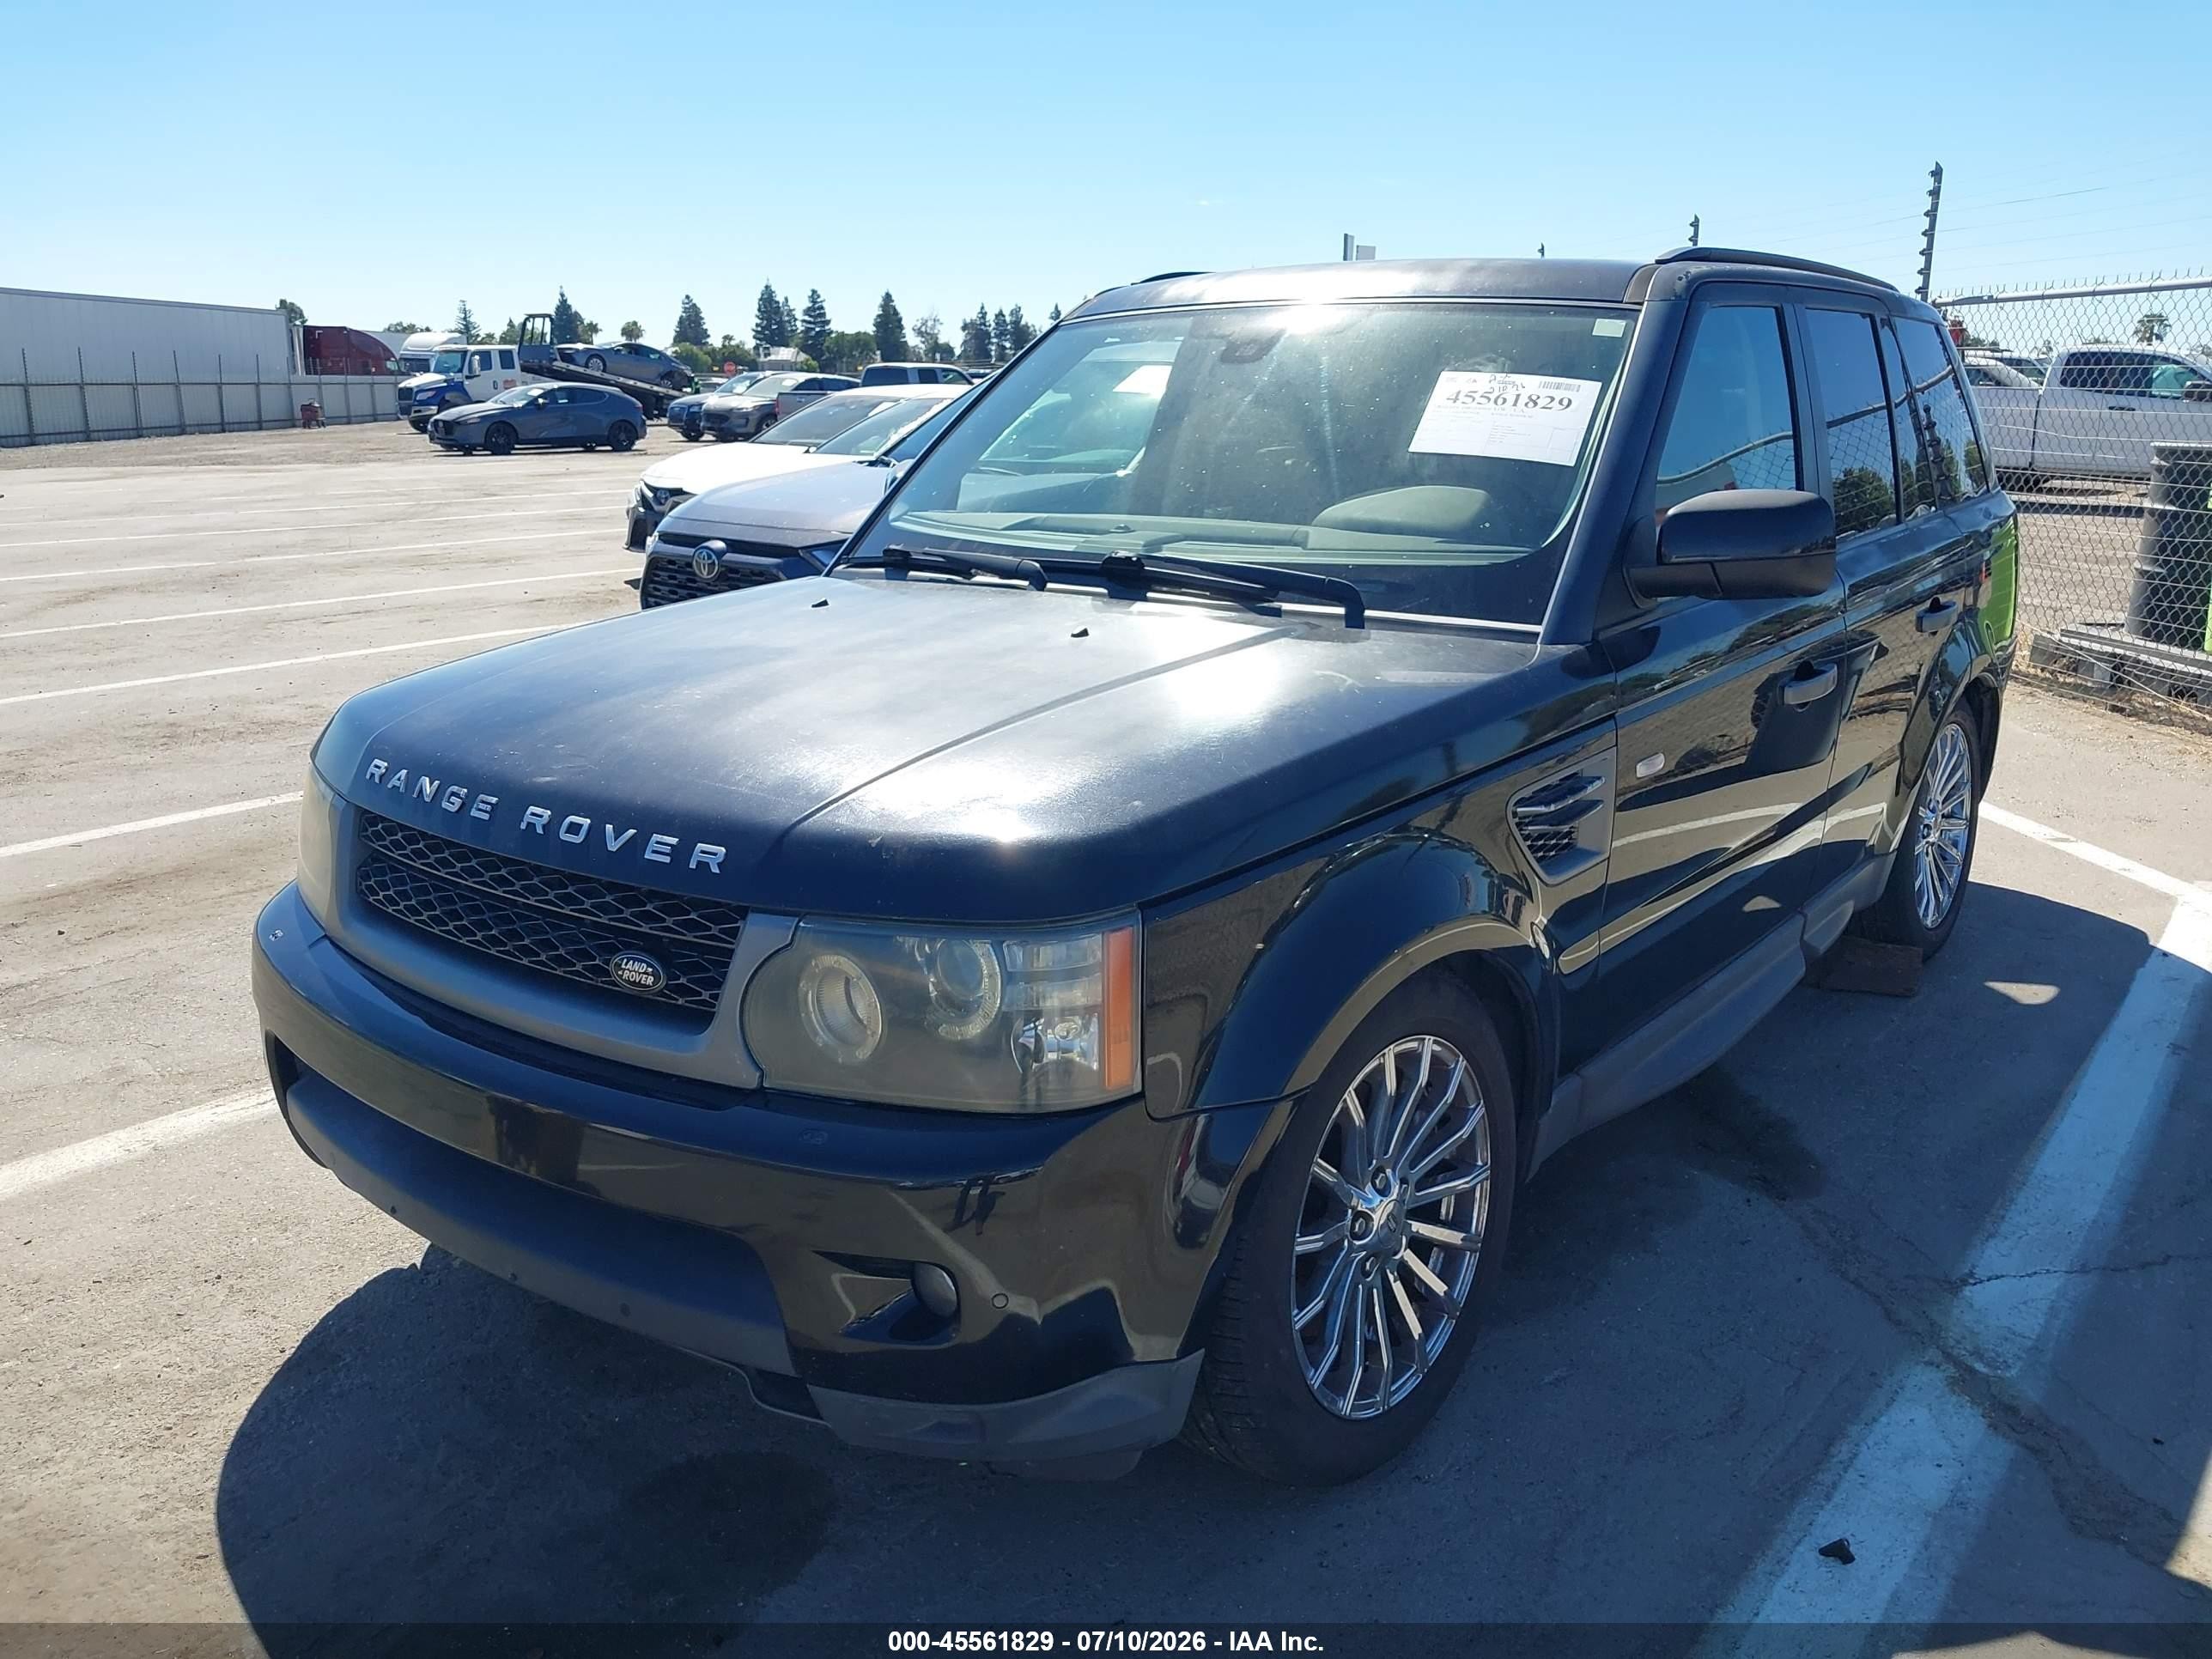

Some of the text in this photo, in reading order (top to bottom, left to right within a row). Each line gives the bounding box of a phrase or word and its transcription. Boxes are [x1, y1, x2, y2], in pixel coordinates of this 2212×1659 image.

[1446, 390, 1572, 411] 45561829
[365, 758, 727, 874] RANGE ROVER
[621, 958, 647, 973] LAND
[622, 969, 654, 986] ROVER
